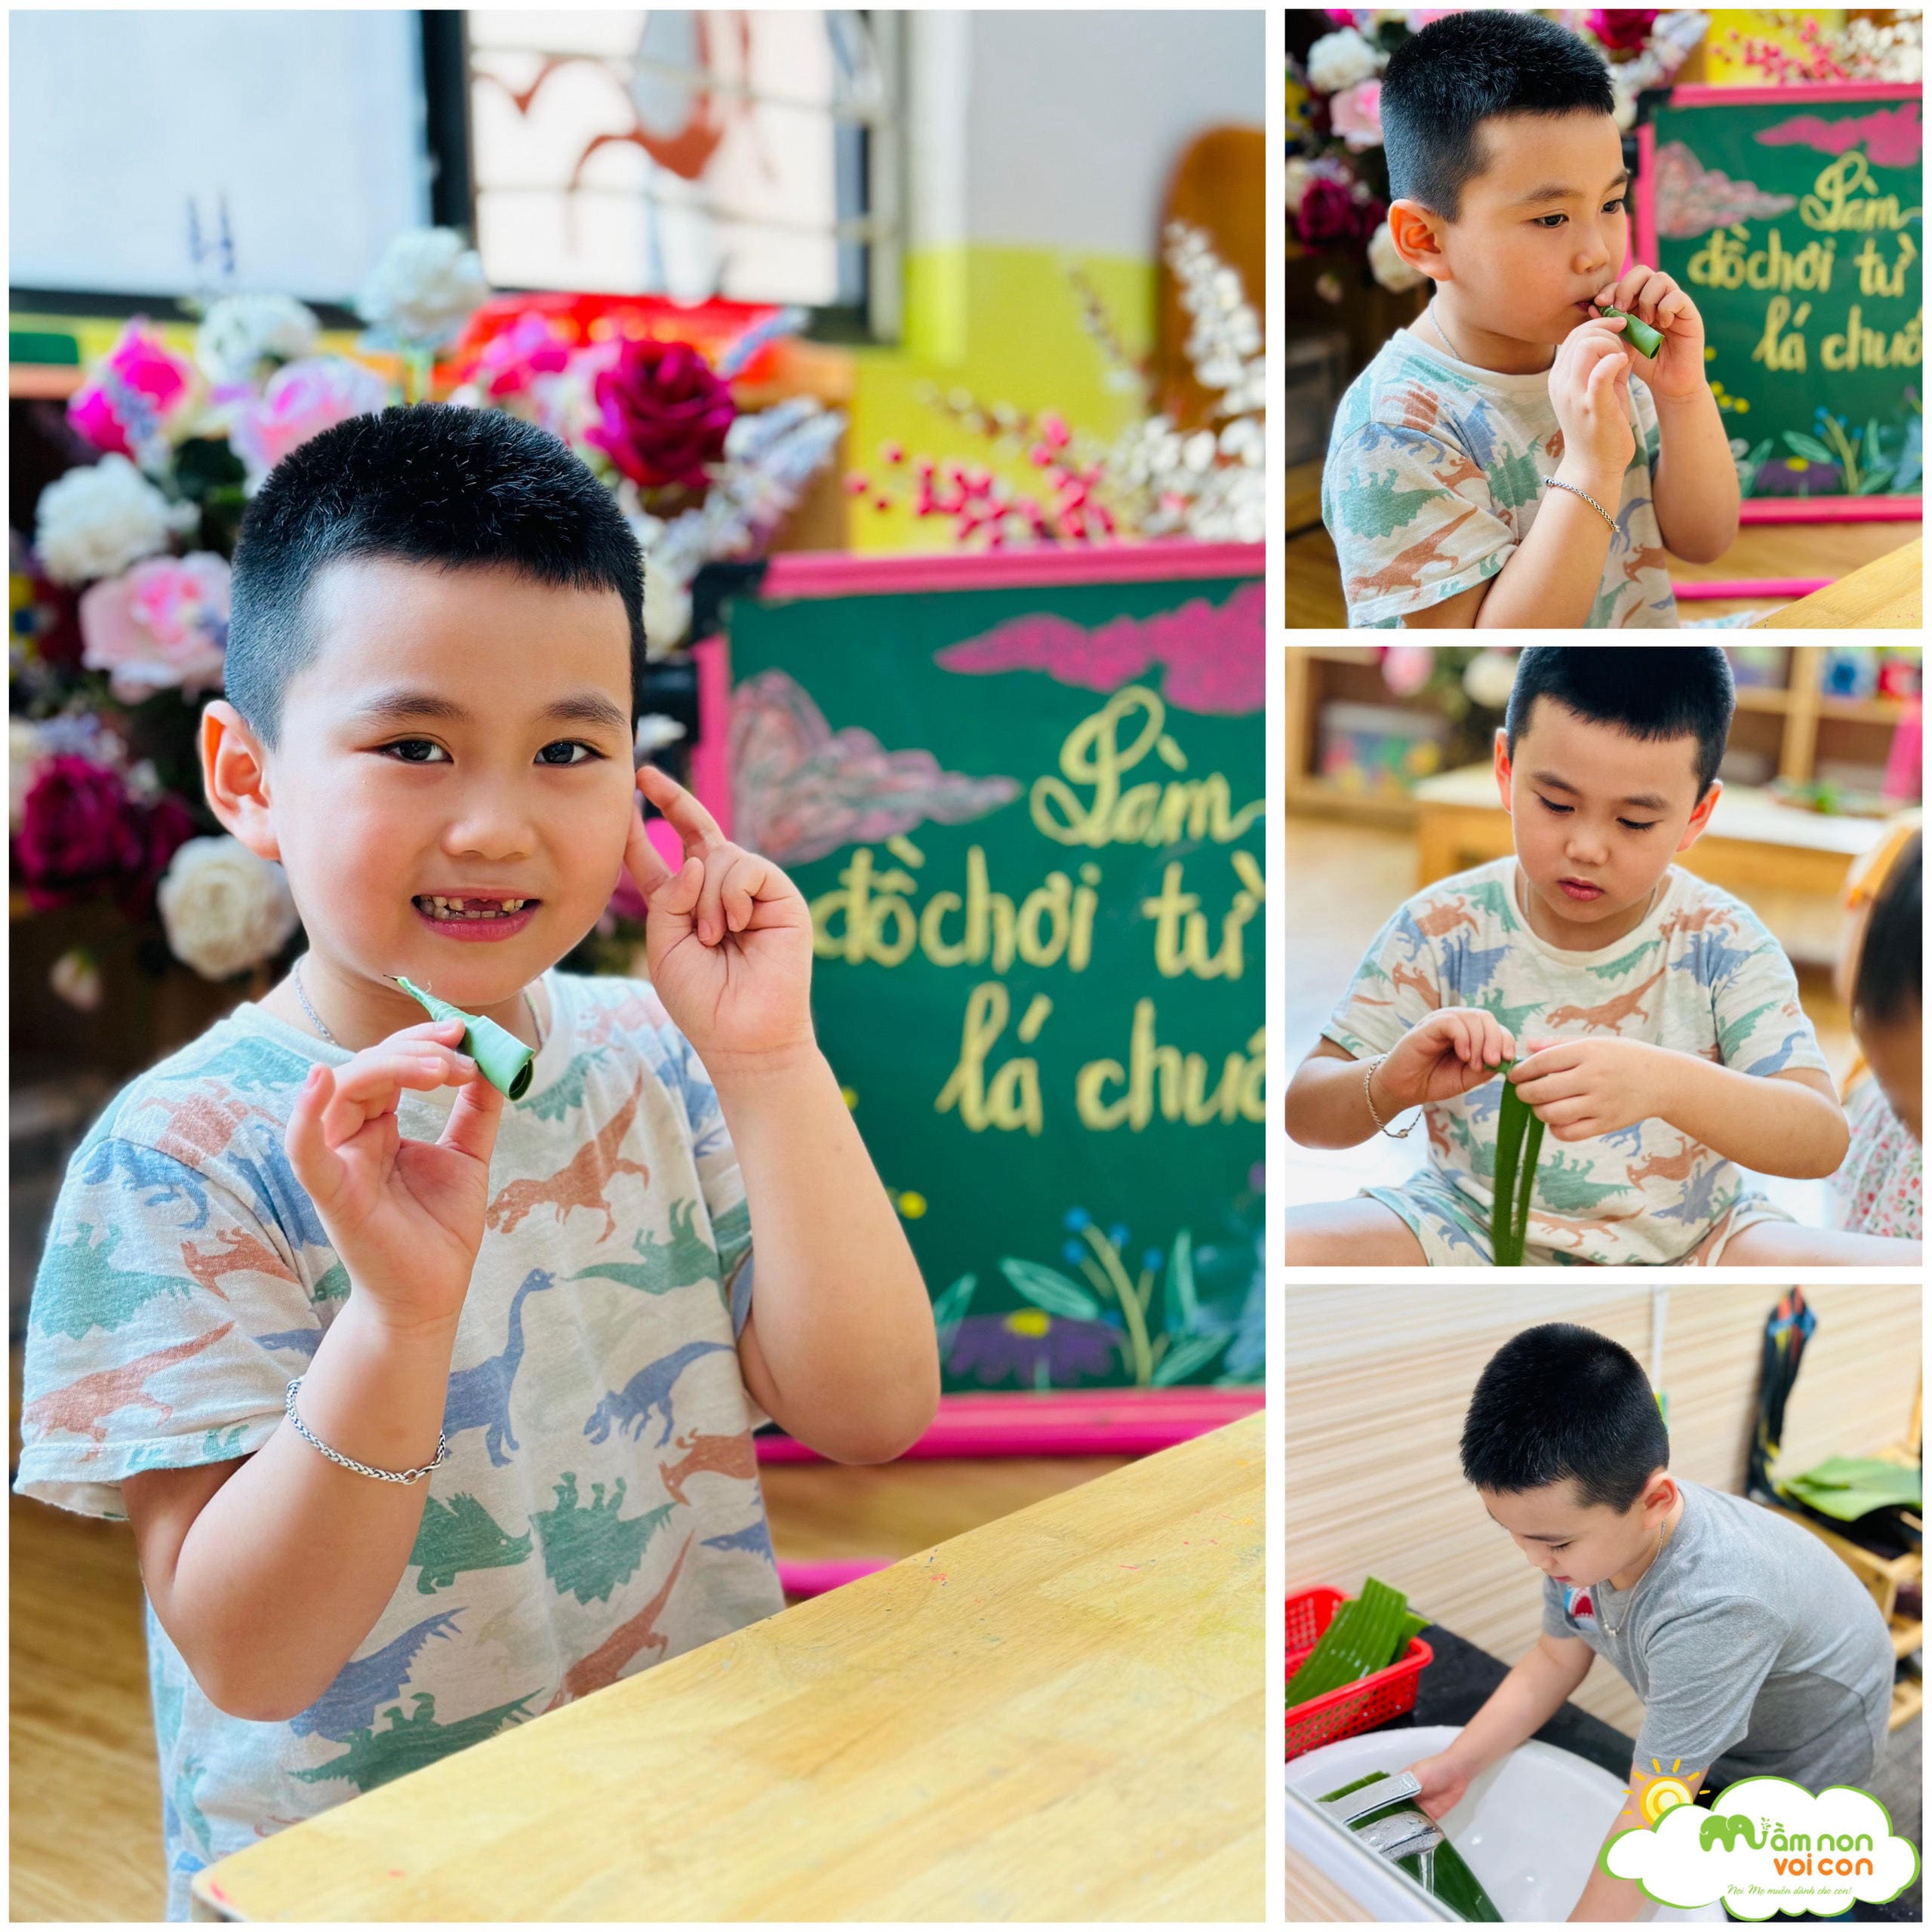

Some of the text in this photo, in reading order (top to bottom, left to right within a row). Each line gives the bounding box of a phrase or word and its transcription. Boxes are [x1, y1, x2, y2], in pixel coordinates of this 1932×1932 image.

[1799, 150, 1923, 232] Làm
[1752, 295, 1811, 373] lá
[1029, 685, 1265, 848] Làm
[934, 981, 1053, 1137] lá
